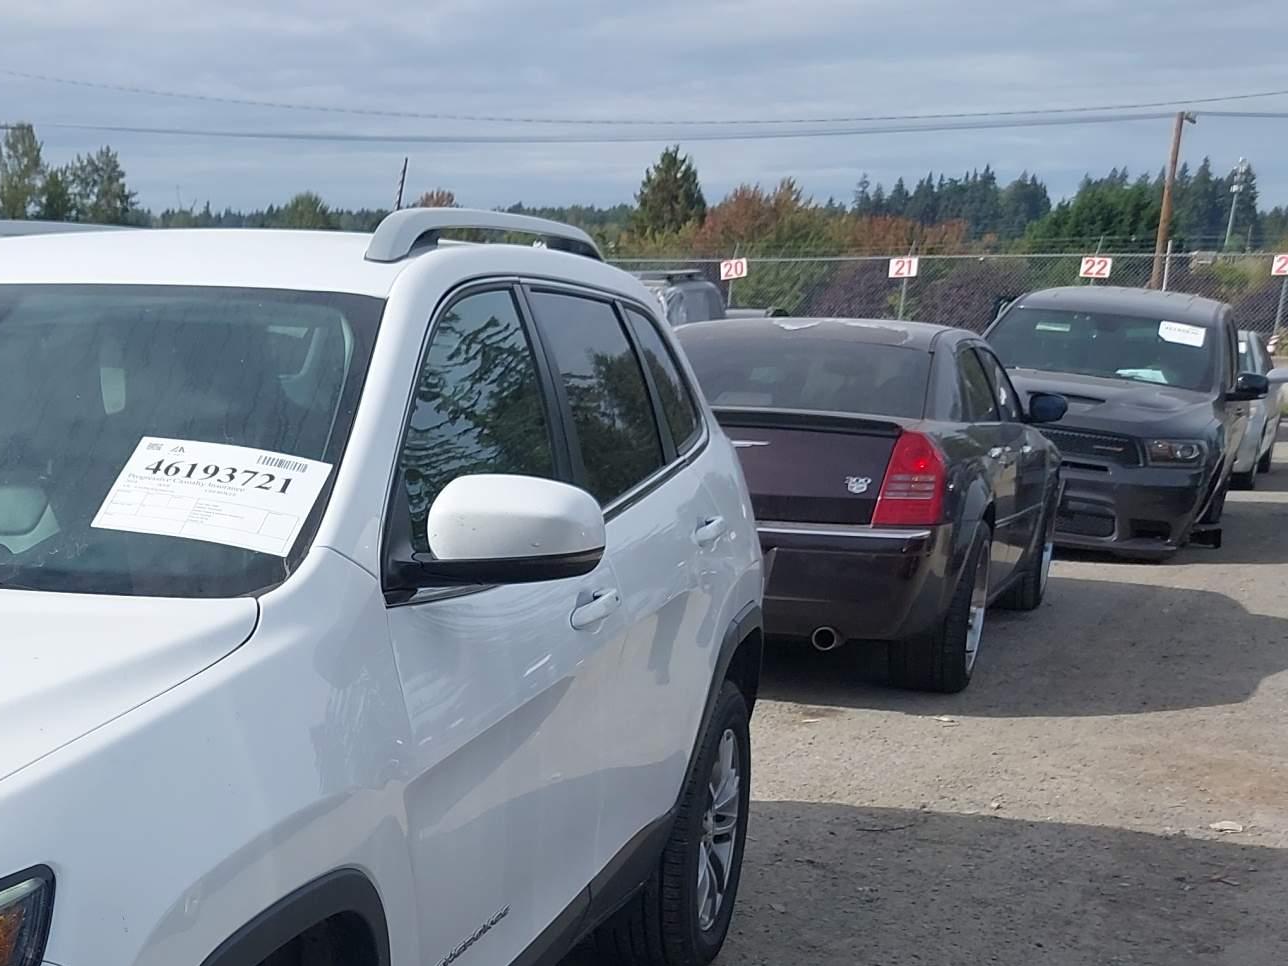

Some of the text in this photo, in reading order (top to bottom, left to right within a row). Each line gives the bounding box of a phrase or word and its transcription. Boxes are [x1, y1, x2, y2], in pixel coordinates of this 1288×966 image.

[724, 261, 744, 278] 20
[895, 259, 912, 276] 21
[1083, 258, 1107, 276] 22
[144, 458, 293, 494] 46193721
